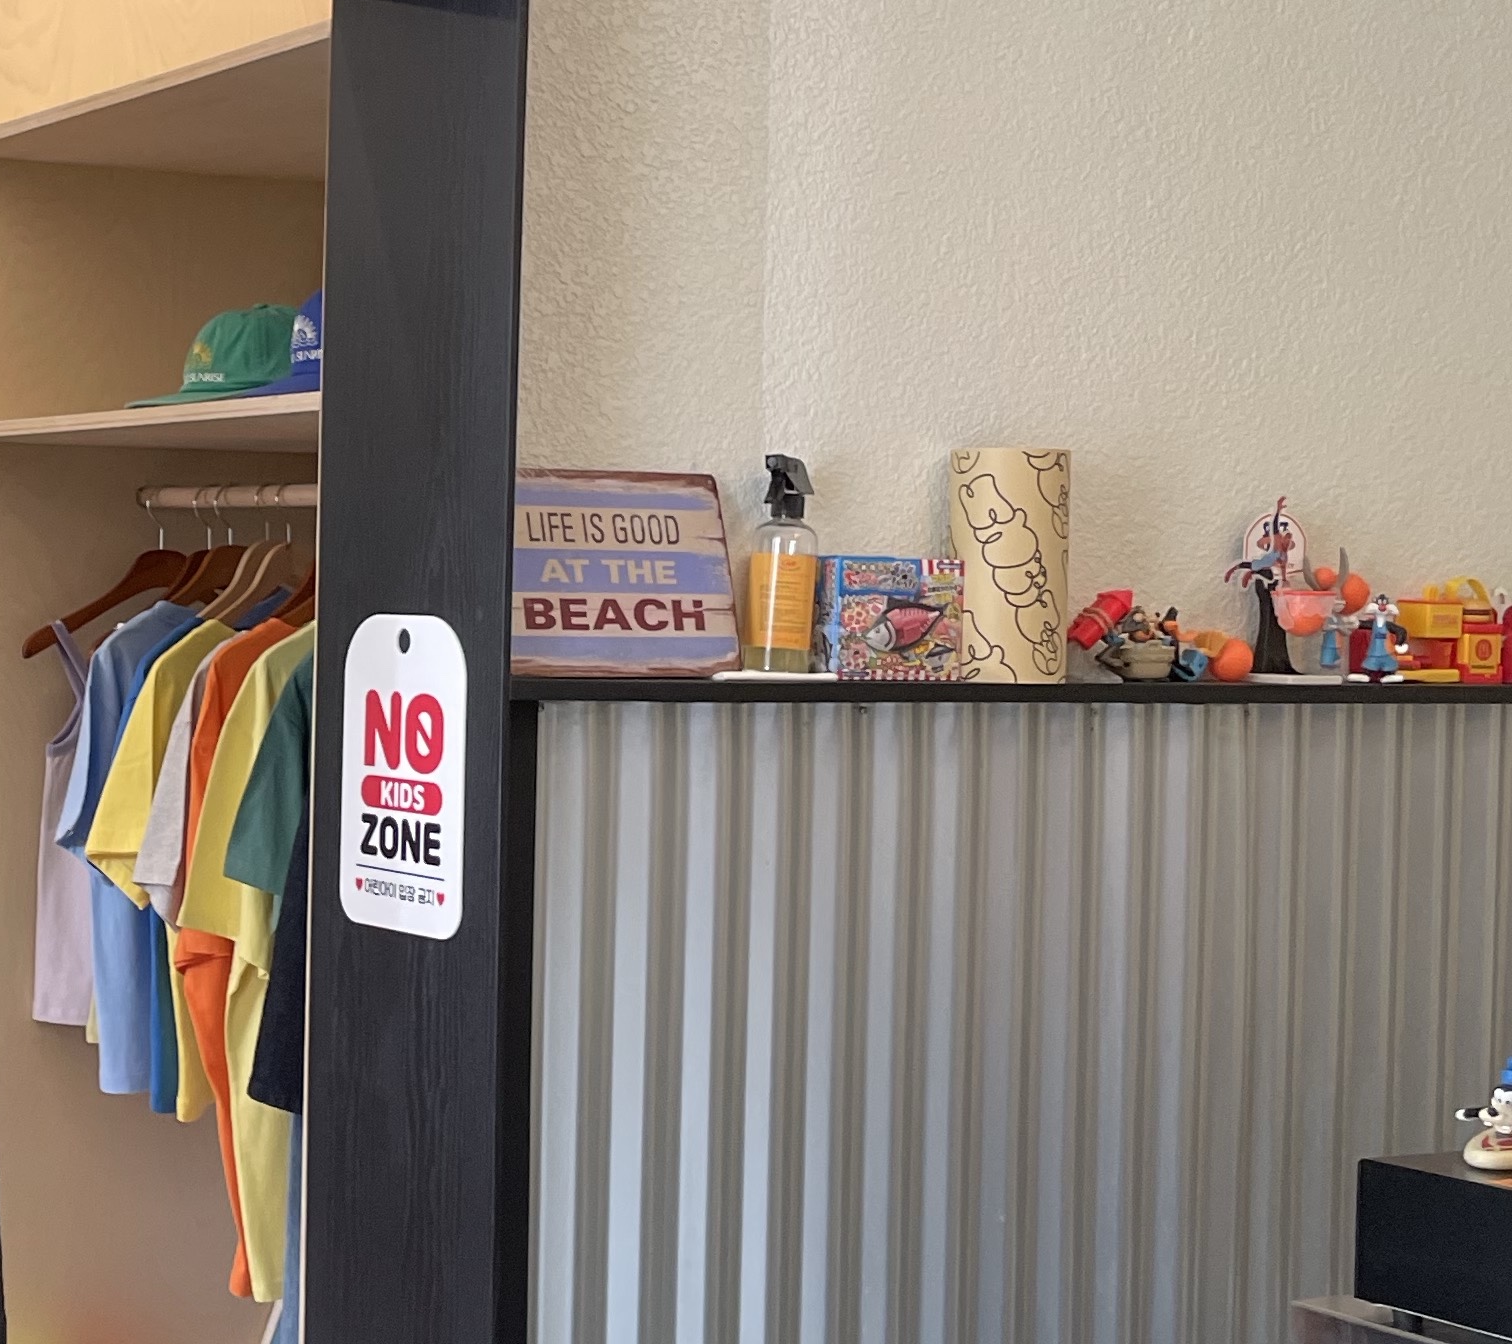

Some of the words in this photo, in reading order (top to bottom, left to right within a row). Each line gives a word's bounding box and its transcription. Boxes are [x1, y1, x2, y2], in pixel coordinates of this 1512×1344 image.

[525, 511, 574, 543] LIFE
[581, 511, 605, 544] IS
[612, 514, 679, 546] GOOD
[539, 557, 590, 584] AT
[606, 558, 678, 586] THE
[522, 597, 707, 632] BEACH
[364, 688, 445, 775] NO
[379, 779, 426, 812] KIDS
[360, 812, 442, 867] ZONE
[398, 884, 416, 903] 입장
